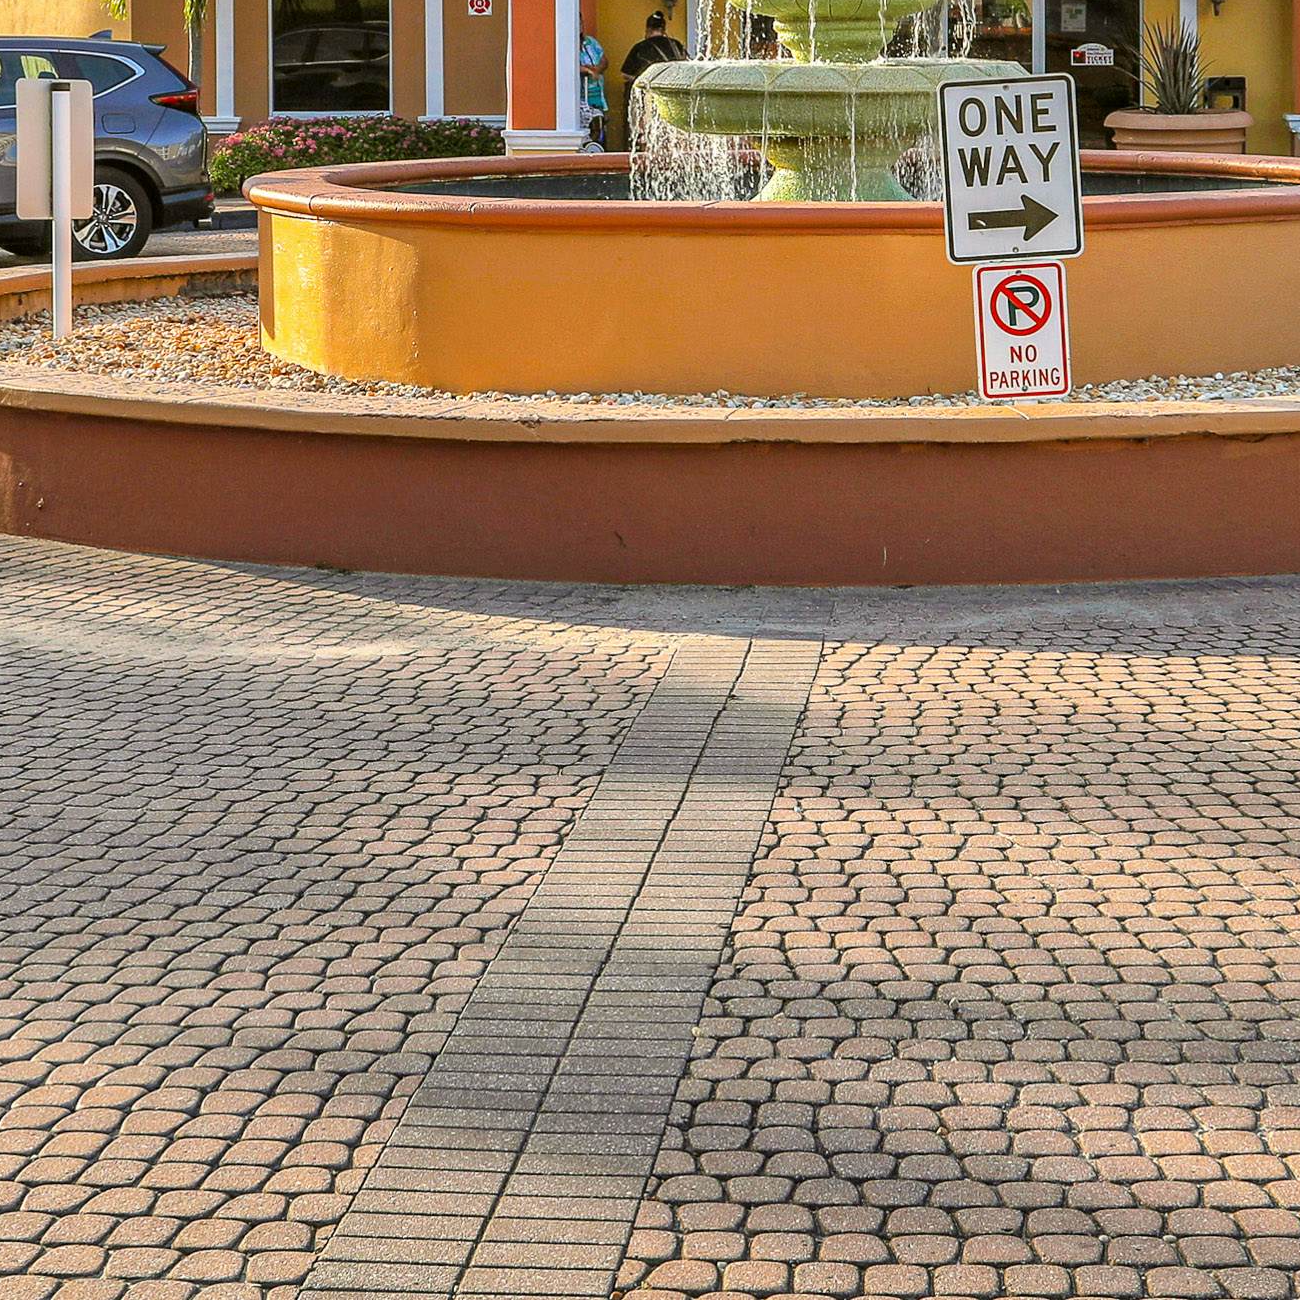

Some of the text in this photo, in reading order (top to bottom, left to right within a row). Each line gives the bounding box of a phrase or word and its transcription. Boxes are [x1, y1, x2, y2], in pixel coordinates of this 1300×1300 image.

[958, 93, 1057, 138] ONE
[957, 142, 1061, 188] WAY
[1010, 345, 1037, 363] NO
[989, 367, 1061, 390] PARKING
